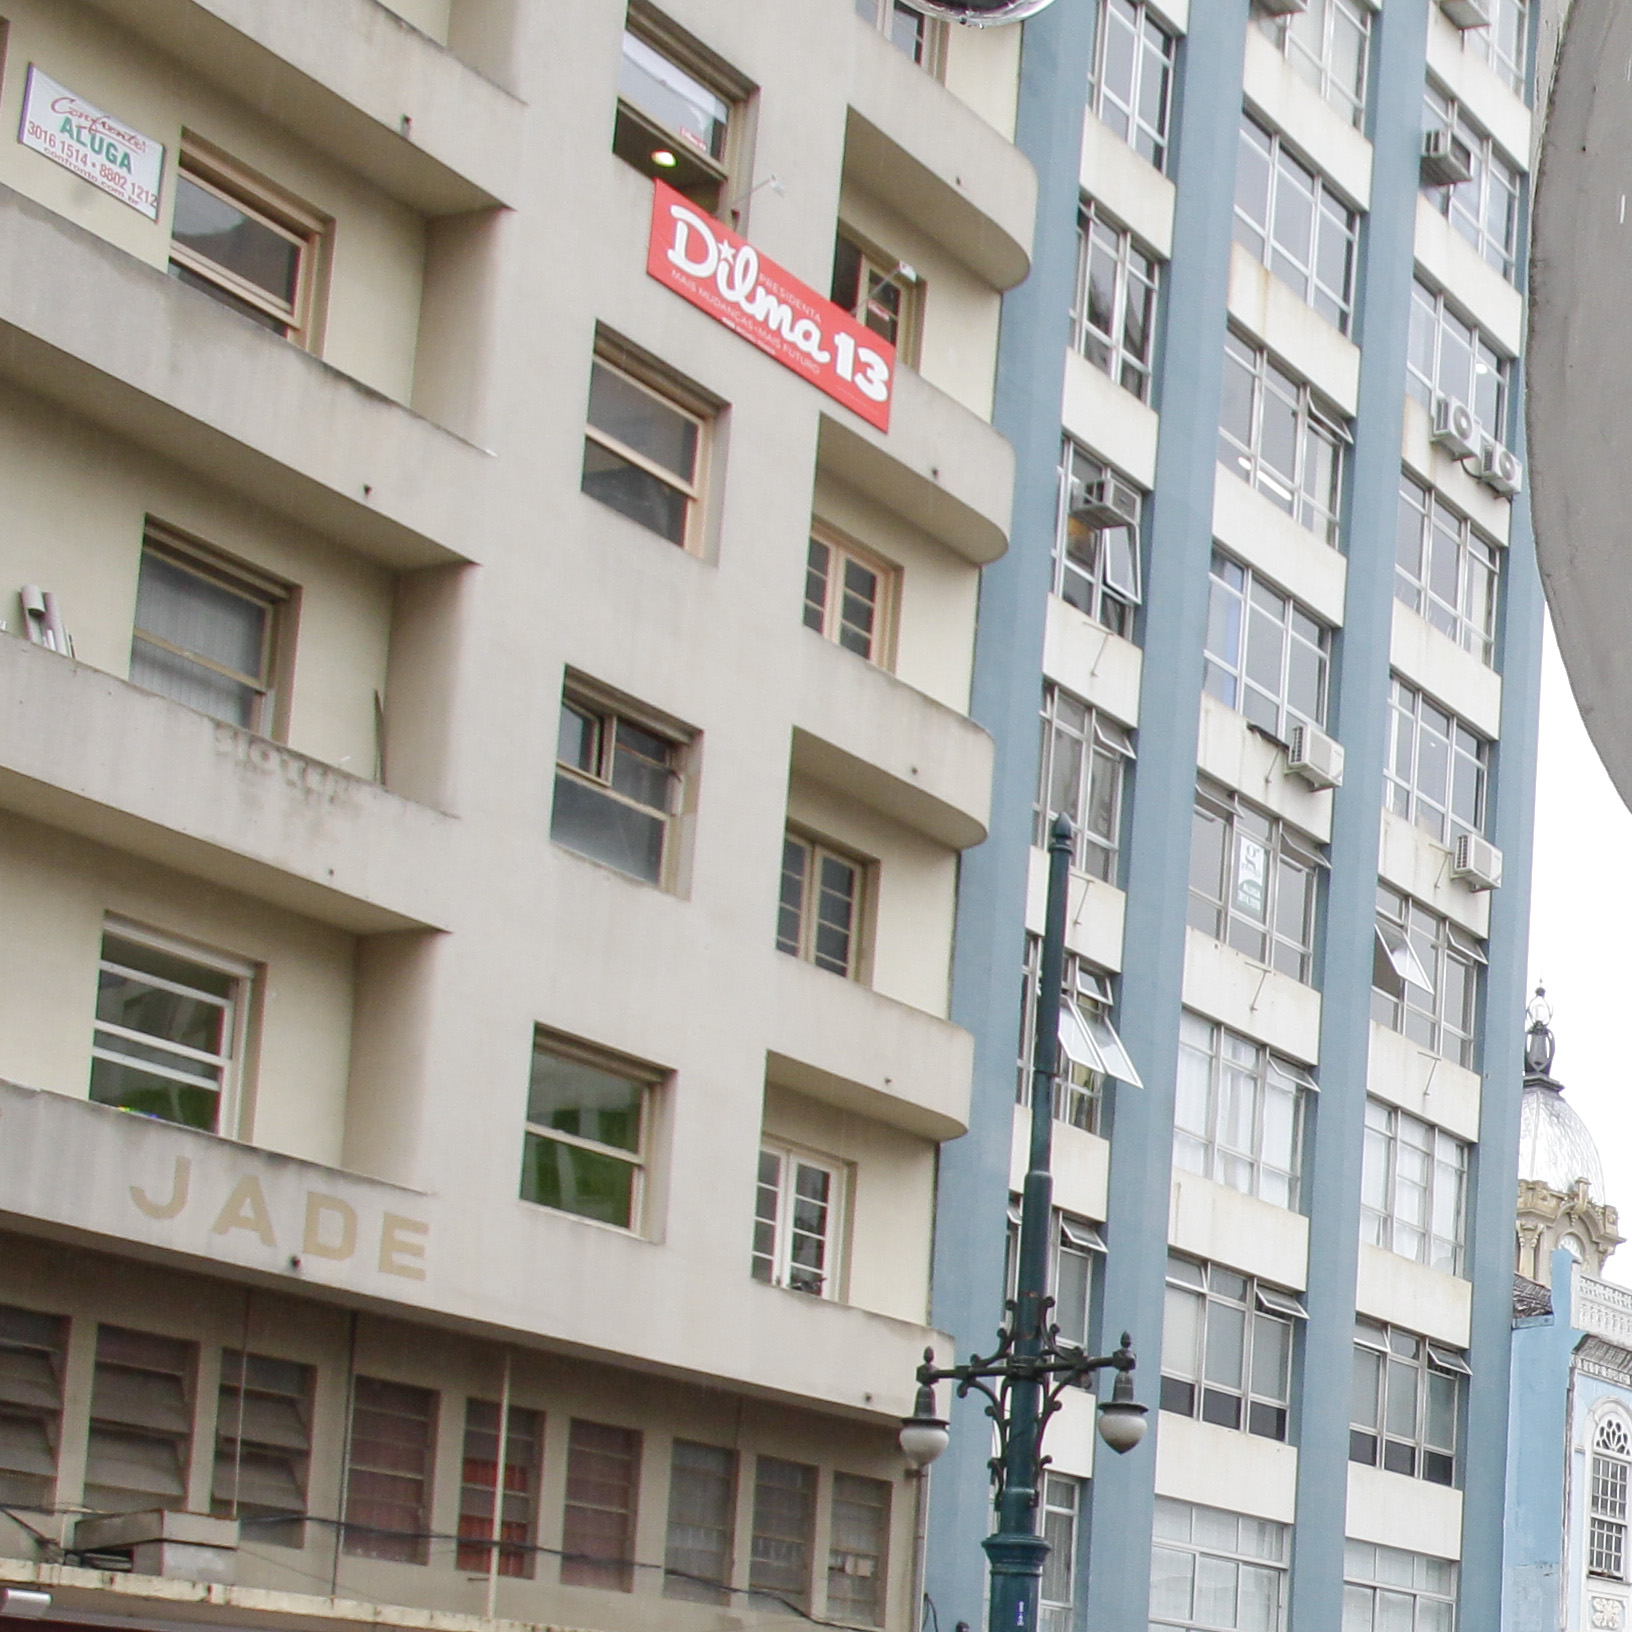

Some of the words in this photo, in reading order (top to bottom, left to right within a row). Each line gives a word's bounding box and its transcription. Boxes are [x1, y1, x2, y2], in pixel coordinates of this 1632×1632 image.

[27, 120, 57, 149] 3016
[60, 140, 88, 168] 1514
[100, 163, 128, 192] 8802
[131, 182, 160, 209] 1212
[60, 116, 132, 174] ALUGA
[667, 204, 831, 364] Dilma
[833, 332, 889, 402] 13
[671, 269, 698, 293] MAIS
[782, 343, 821, 375] FUTURO
[757, 272, 822, 324] PRESIDENTA
[129, 1155, 430, 1281] JADE
